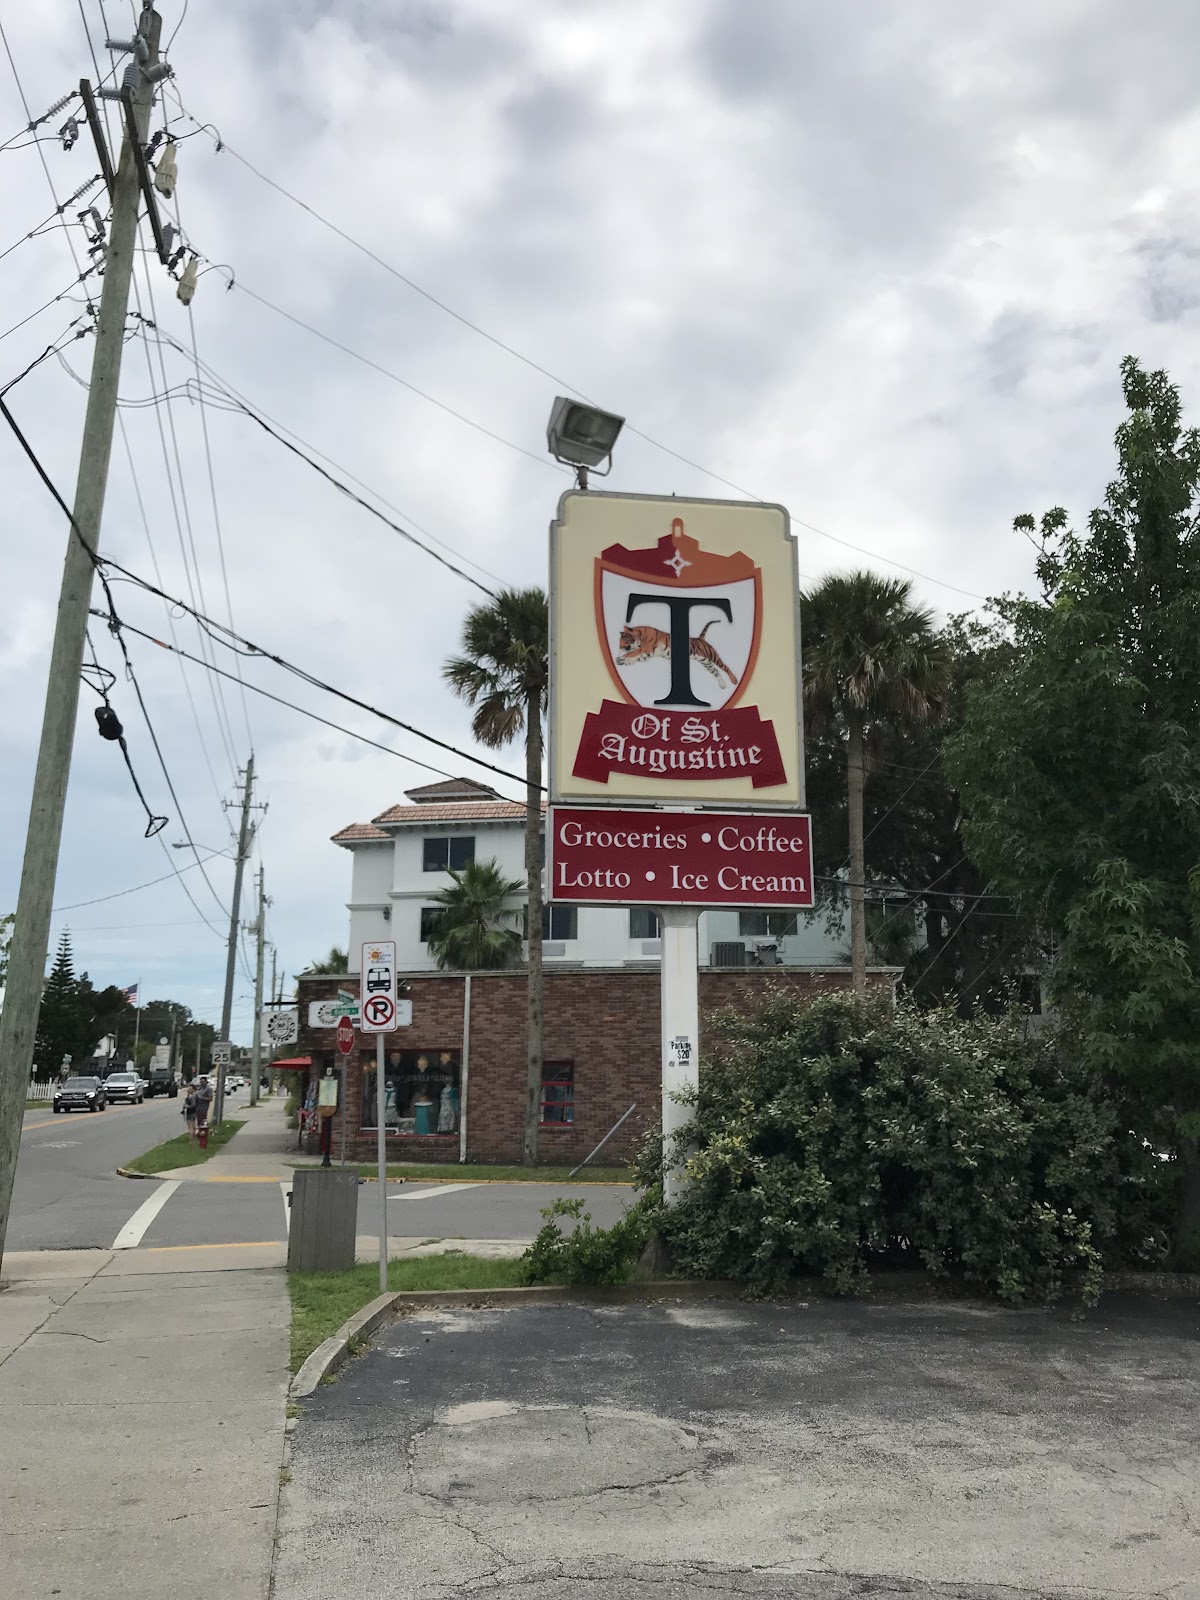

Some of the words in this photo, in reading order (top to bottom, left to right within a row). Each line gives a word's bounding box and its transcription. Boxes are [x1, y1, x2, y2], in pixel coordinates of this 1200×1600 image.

[626, 593, 733, 706] T
[631, 714, 671, 741] Of
[681, 718, 730, 744] St.
[598, 733, 763, 773] Augustine
[559, 822, 688, 850] Groceries
[717, 826, 804, 853] Coffee
[558, 863, 631, 889] Lotto
[671, 865, 709, 891] Ice
[717, 866, 807, 894] Cream
[338, 1027, 353, 1043] STOP
[671, 1041, 692, 1051] Parking
[214, 1053, 229, 1062] 25
[677, 1049, 690, 1060] $20
